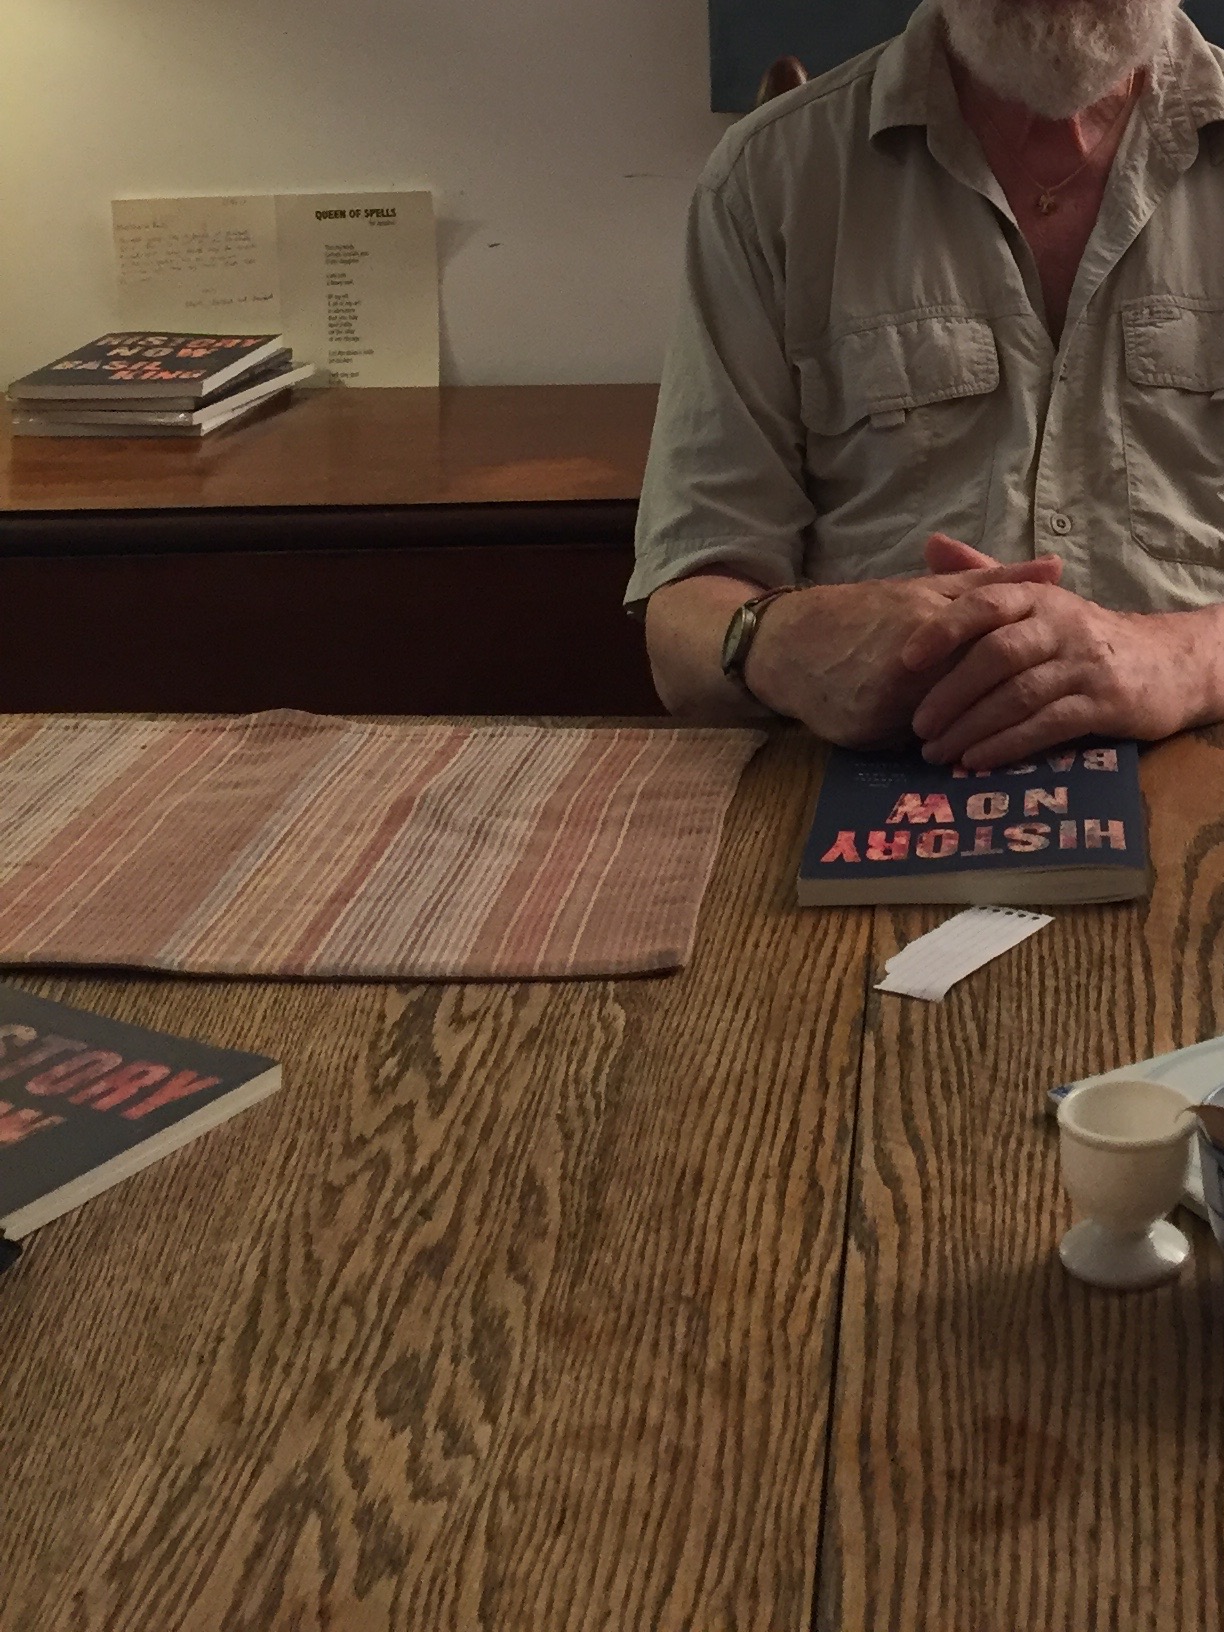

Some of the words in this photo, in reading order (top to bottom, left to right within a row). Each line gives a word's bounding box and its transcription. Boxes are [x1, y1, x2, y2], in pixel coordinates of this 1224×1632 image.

[315, 209, 346, 220] QUEEN
[349, 209, 362, 218] OF
[364, 207, 396, 218] SPELLS
[107, 346, 220, 358] NOW
[886, 786, 1069, 825] NOW
[820, 818, 1127, 863] HISTORY
